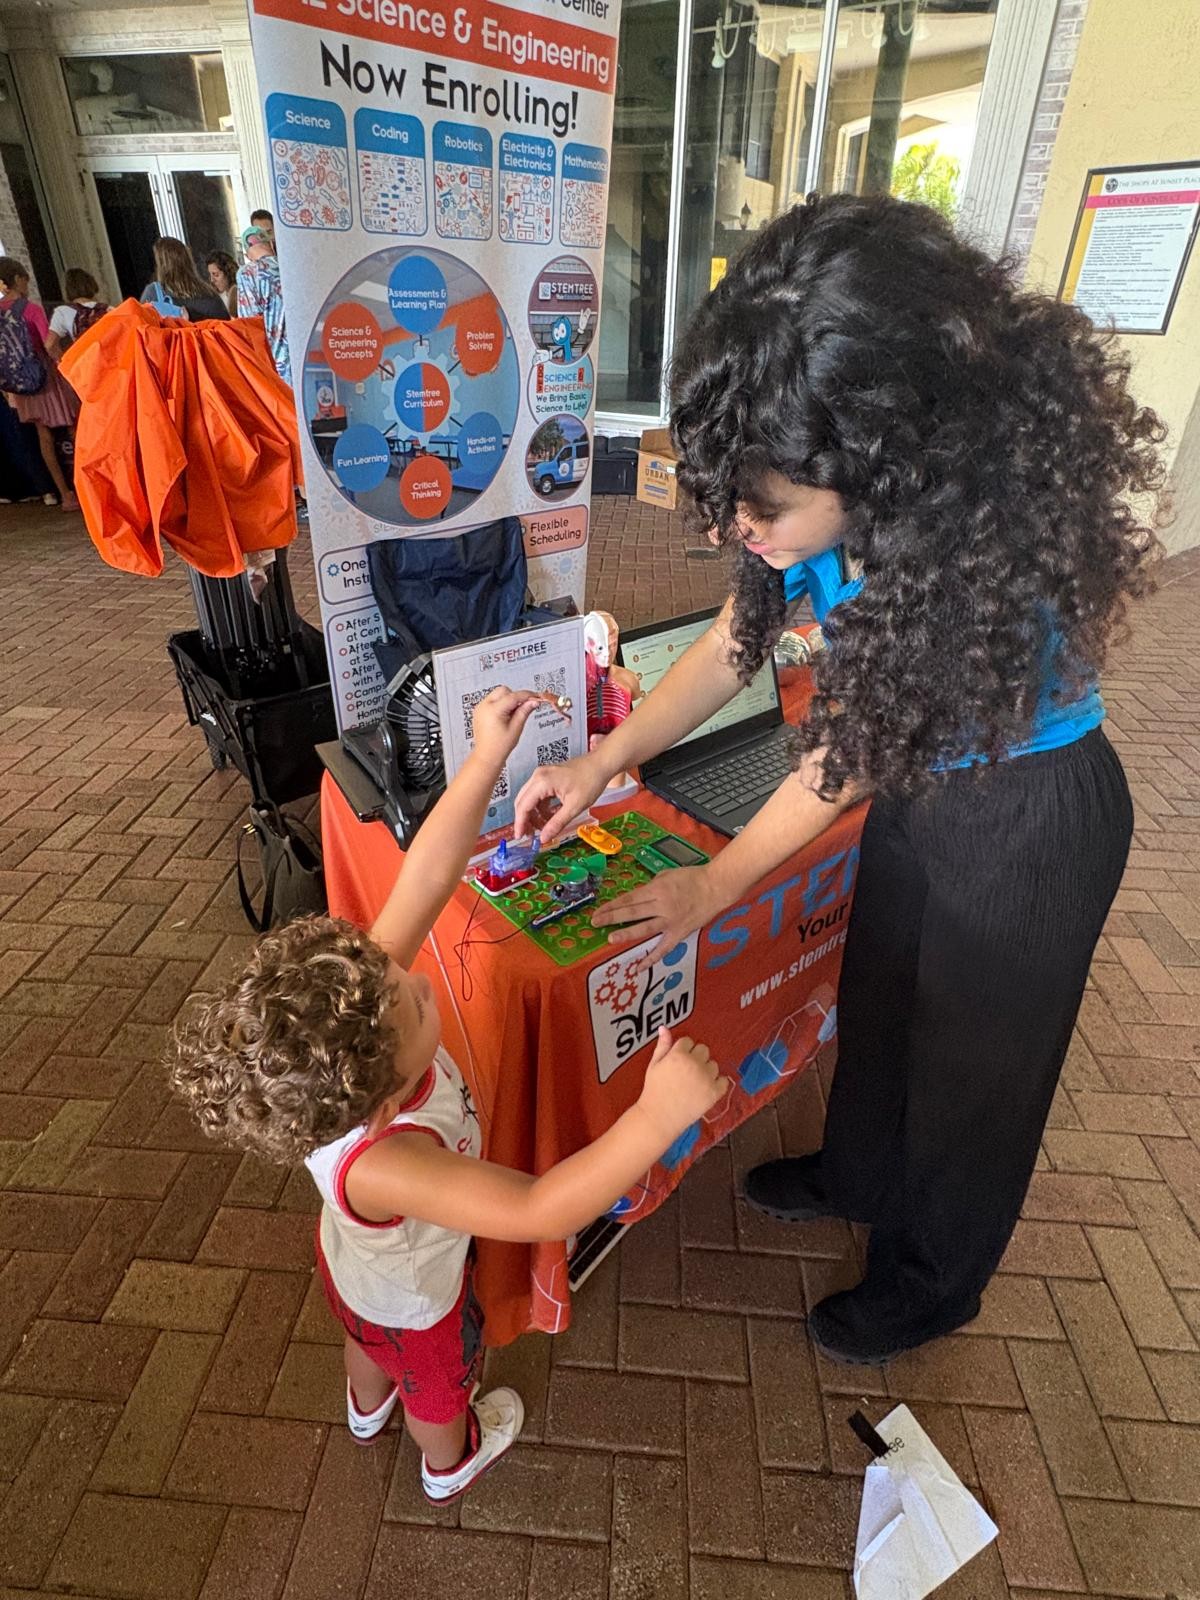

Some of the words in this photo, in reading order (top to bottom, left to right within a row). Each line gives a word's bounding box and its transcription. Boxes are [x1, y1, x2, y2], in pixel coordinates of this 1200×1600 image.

[453, 7, 472, 44] &
[481, 16, 610, 84] Engineering
[320, 39, 407, 100] Now
[422, 61, 579, 138] Enrolling!
[285, 109, 331, 129] Science
[372, 123, 409, 144] Coding
[444, 135, 483, 152] Robotics
[502, 138, 546, 159] Electricity
[547, 145, 554, 157] &
[503, 154, 552, 171] Electronics
[388, 287, 440, 298] Assessments
[551, 282, 594, 294] STEMTREE
[391, 299, 427, 311] Learning
[428, 299, 447, 309] Plan
[331, 327, 364, 336] Science
[466, 331, 495, 340] Problem
[328, 338, 378, 350] Engineering
[468, 342, 493, 351] Solving
[334, 350, 374, 360] Concepts
[544, 373, 577, 383] SCIENCE
[405, 389, 441, 399] Stemtree
[544, 383, 593, 393] ENGINEERING
[403, 399, 444, 409] Curriculum
[549, 394, 567, 403] Bring
[535, 405, 563, 413] Science
[337, 458, 353, 468] Fun
[353, 454, 388, 465] Learning
[412, 479, 439, 490] Critical
[410, 489, 442, 500] Thinking
[530, 517, 569, 533] Flexible
[529, 529, 581, 546] Scheduling
[341, 559, 367, 572] One
[346, 616, 371, 630] After
[346, 631, 358, 642] at
[360, 625, 382, 638] Cen
[349, 642, 373, 654] Afte
[493, 640, 547, 663] STEMTREE
[352, 663, 376, 677] After
[352, 674, 373, 687] with
[797, 902, 849, 944] Your
